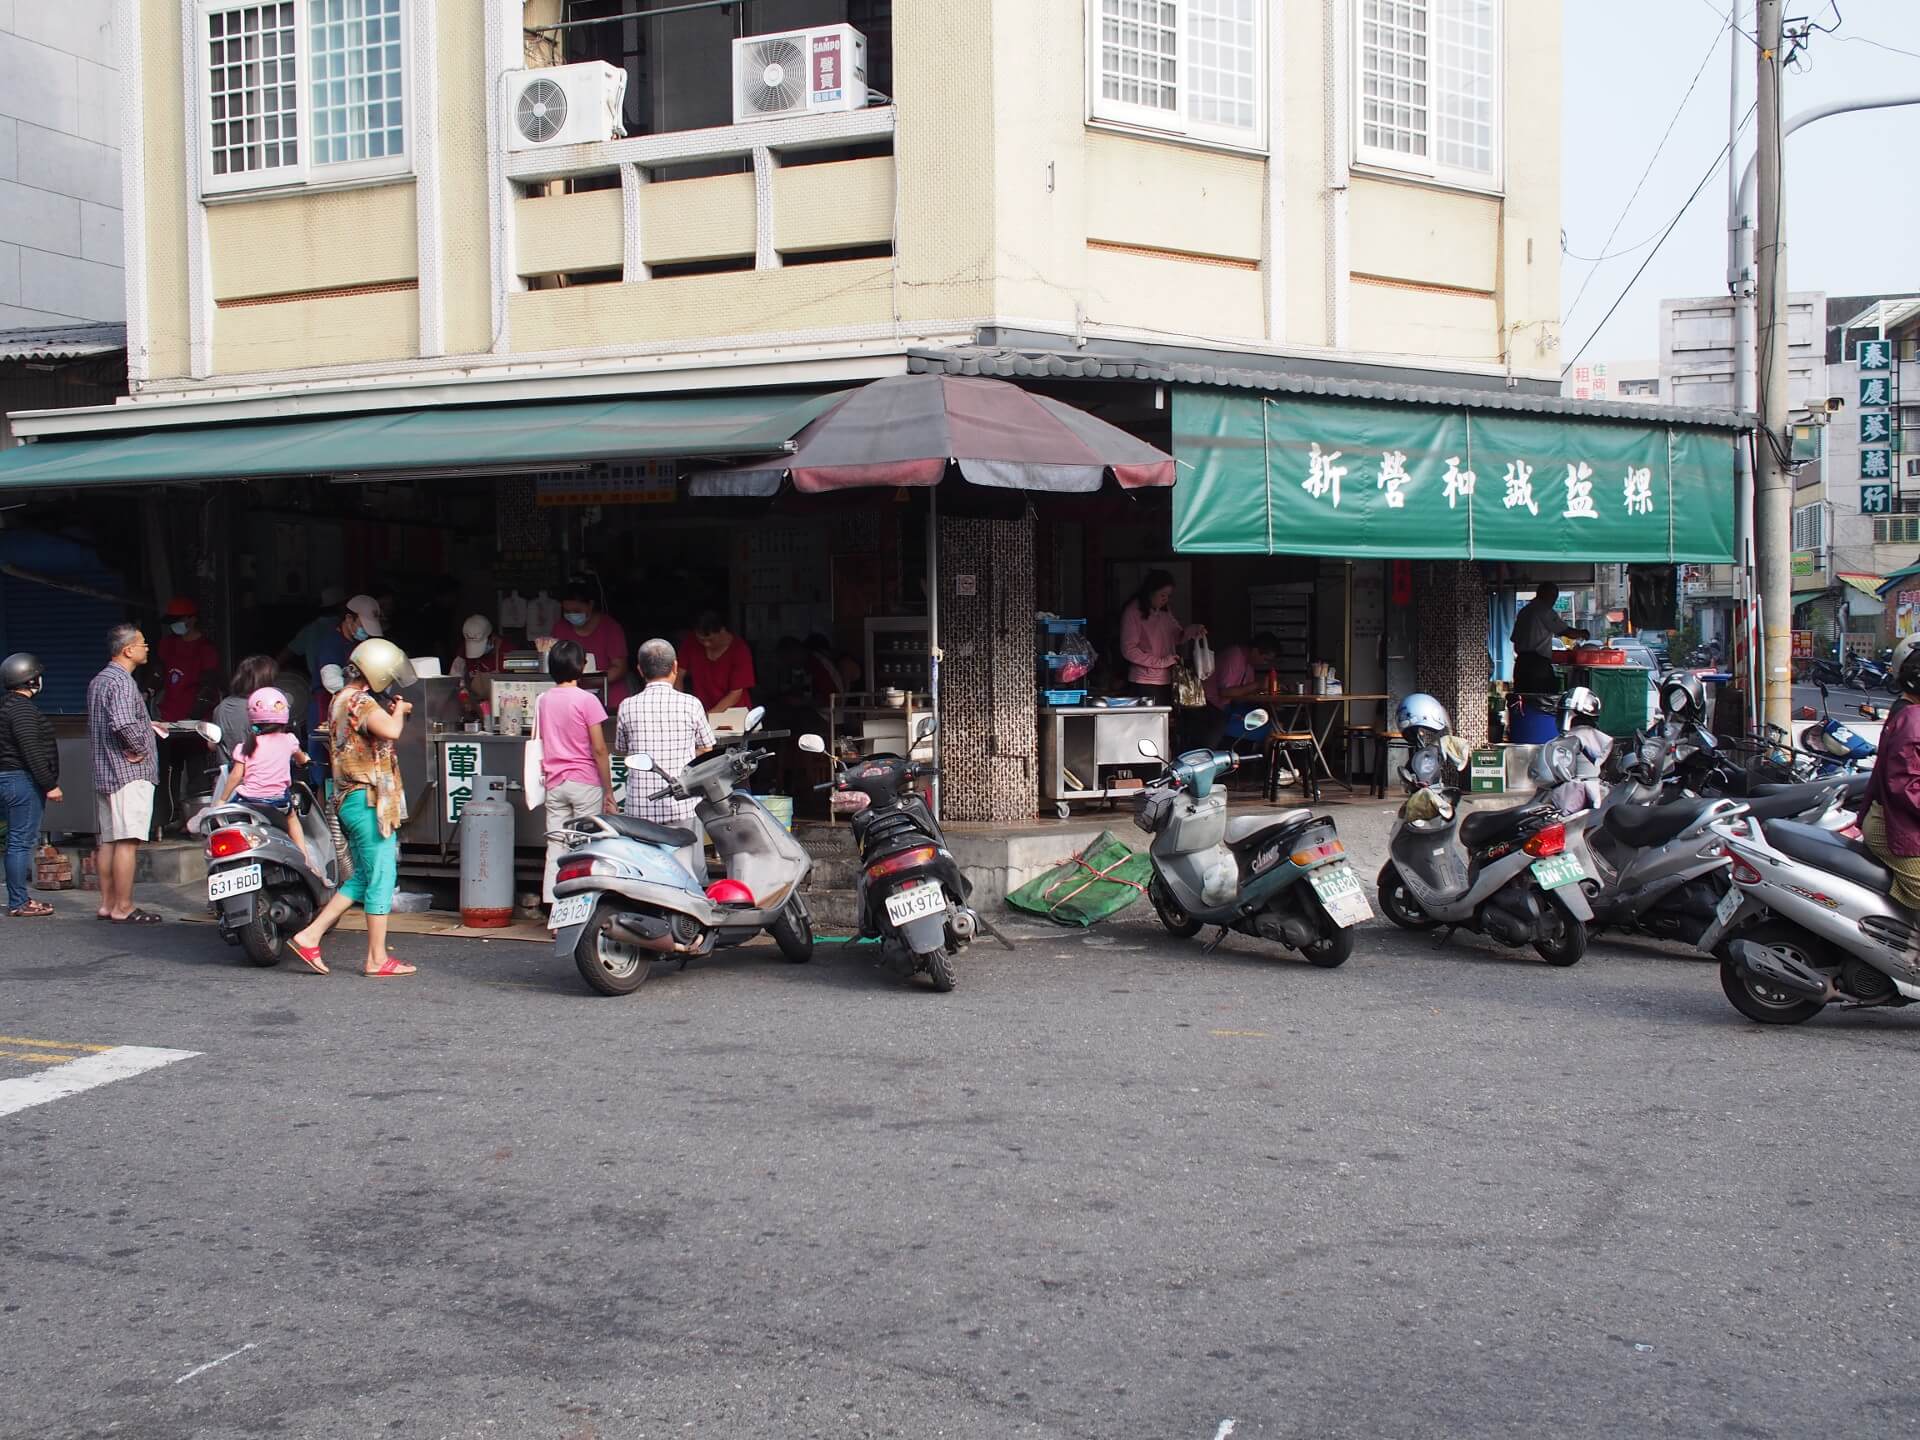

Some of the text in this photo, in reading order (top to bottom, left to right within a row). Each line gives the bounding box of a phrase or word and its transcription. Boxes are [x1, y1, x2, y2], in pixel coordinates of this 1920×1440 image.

[813, 39, 840, 53] SAMPO
[210, 872, 260, 896] 631-BDD
[889, 891, 943, 921] NUX-972
